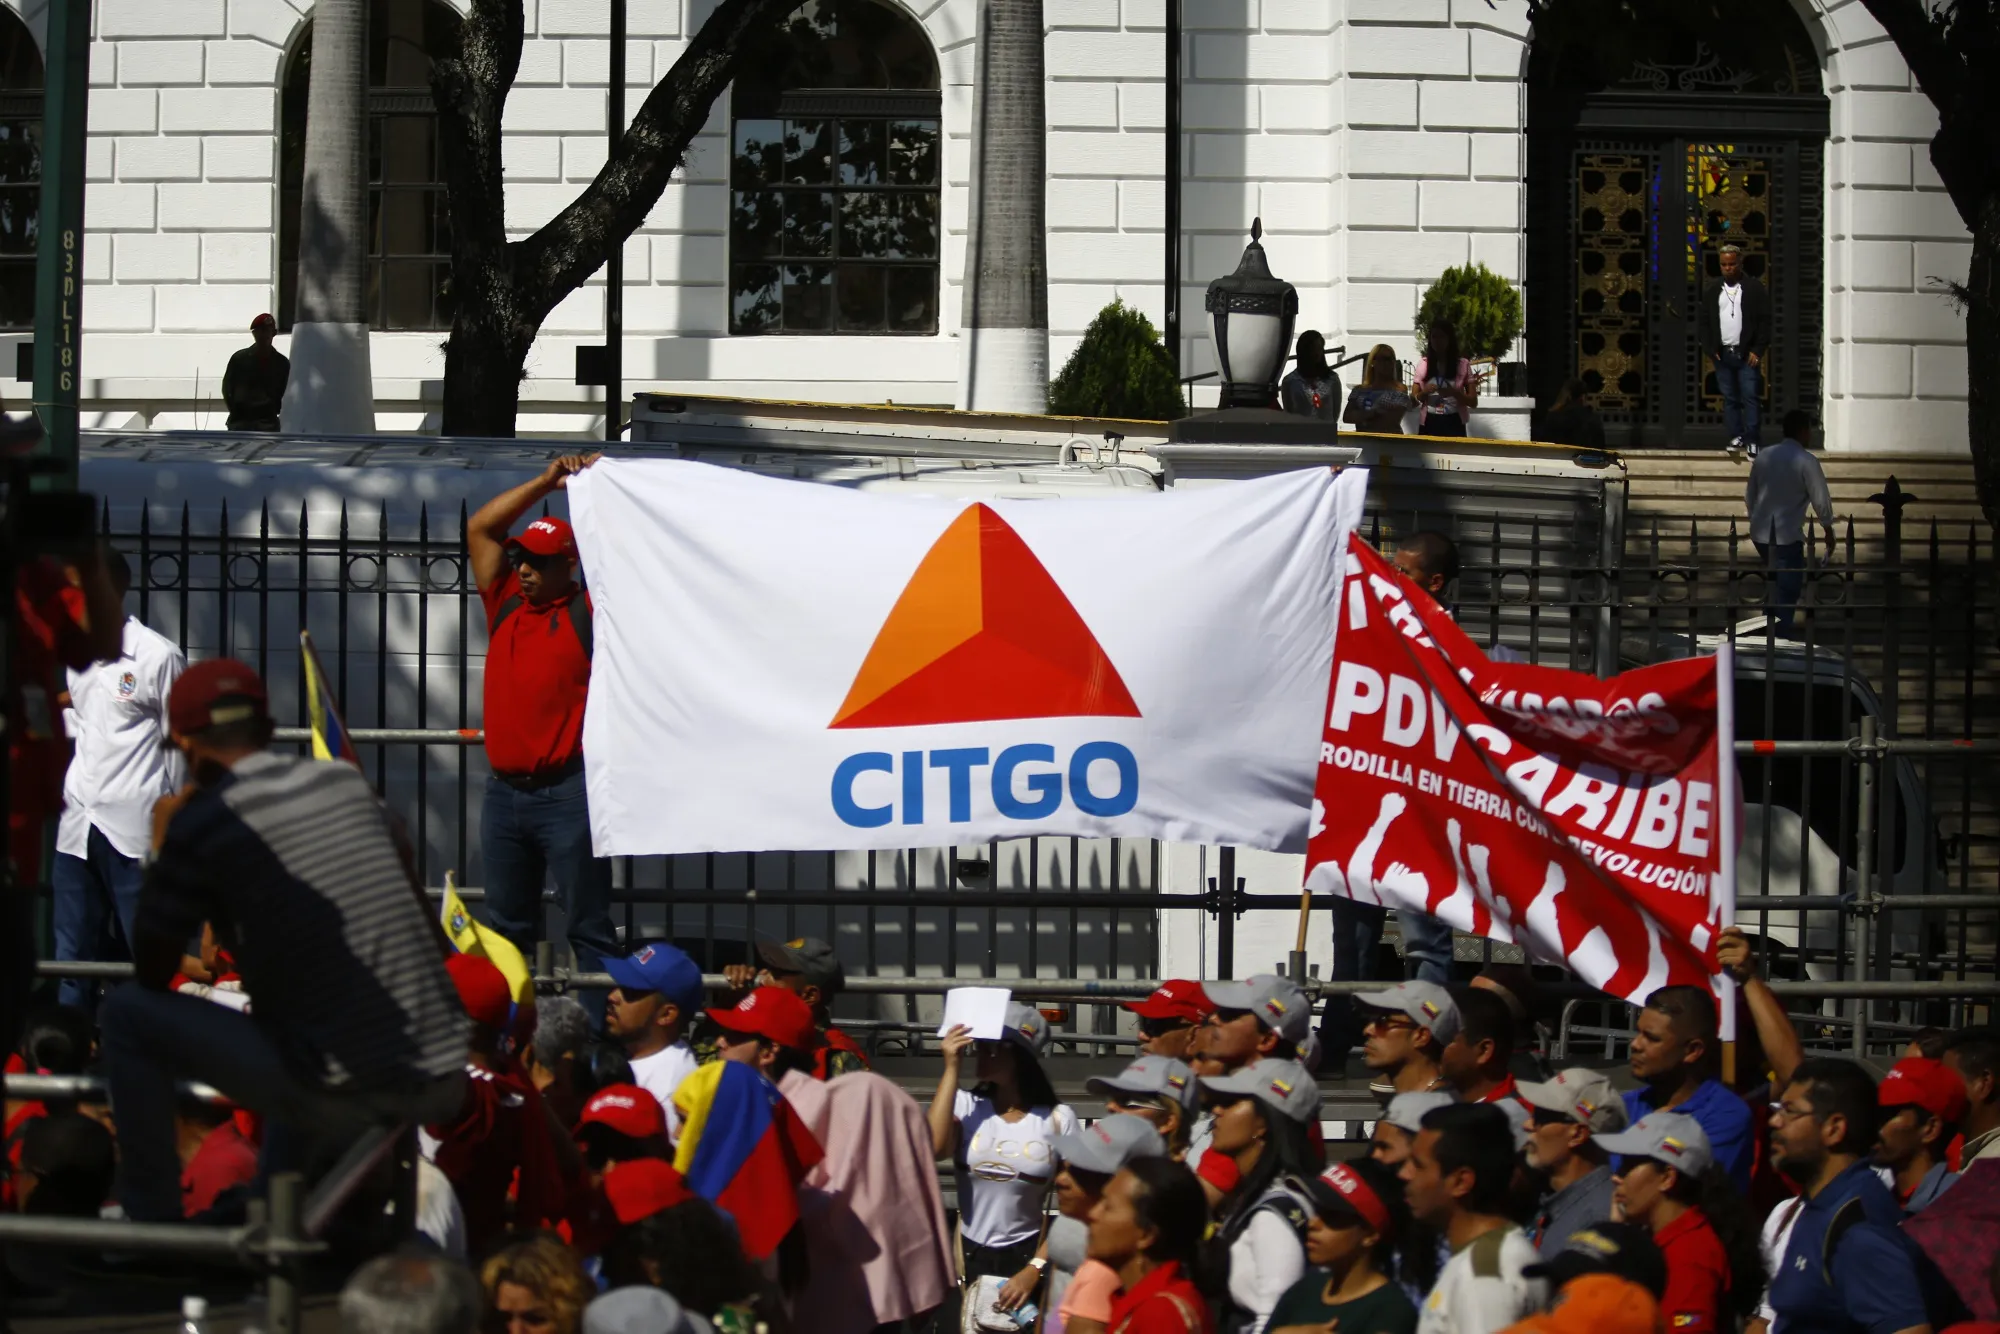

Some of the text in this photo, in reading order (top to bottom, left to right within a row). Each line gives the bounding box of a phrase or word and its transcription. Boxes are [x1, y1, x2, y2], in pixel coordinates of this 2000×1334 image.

[60, 230, 75, 391] 83DL186
[831, 741, 1139, 828] CITGO
[1319, 741, 1414, 787] RODILLA
[1417, 768, 1444, 797] EN
[1447, 778, 1512, 822] TIERRA
[1329, 660, 1713, 859] PDV CARIBE
